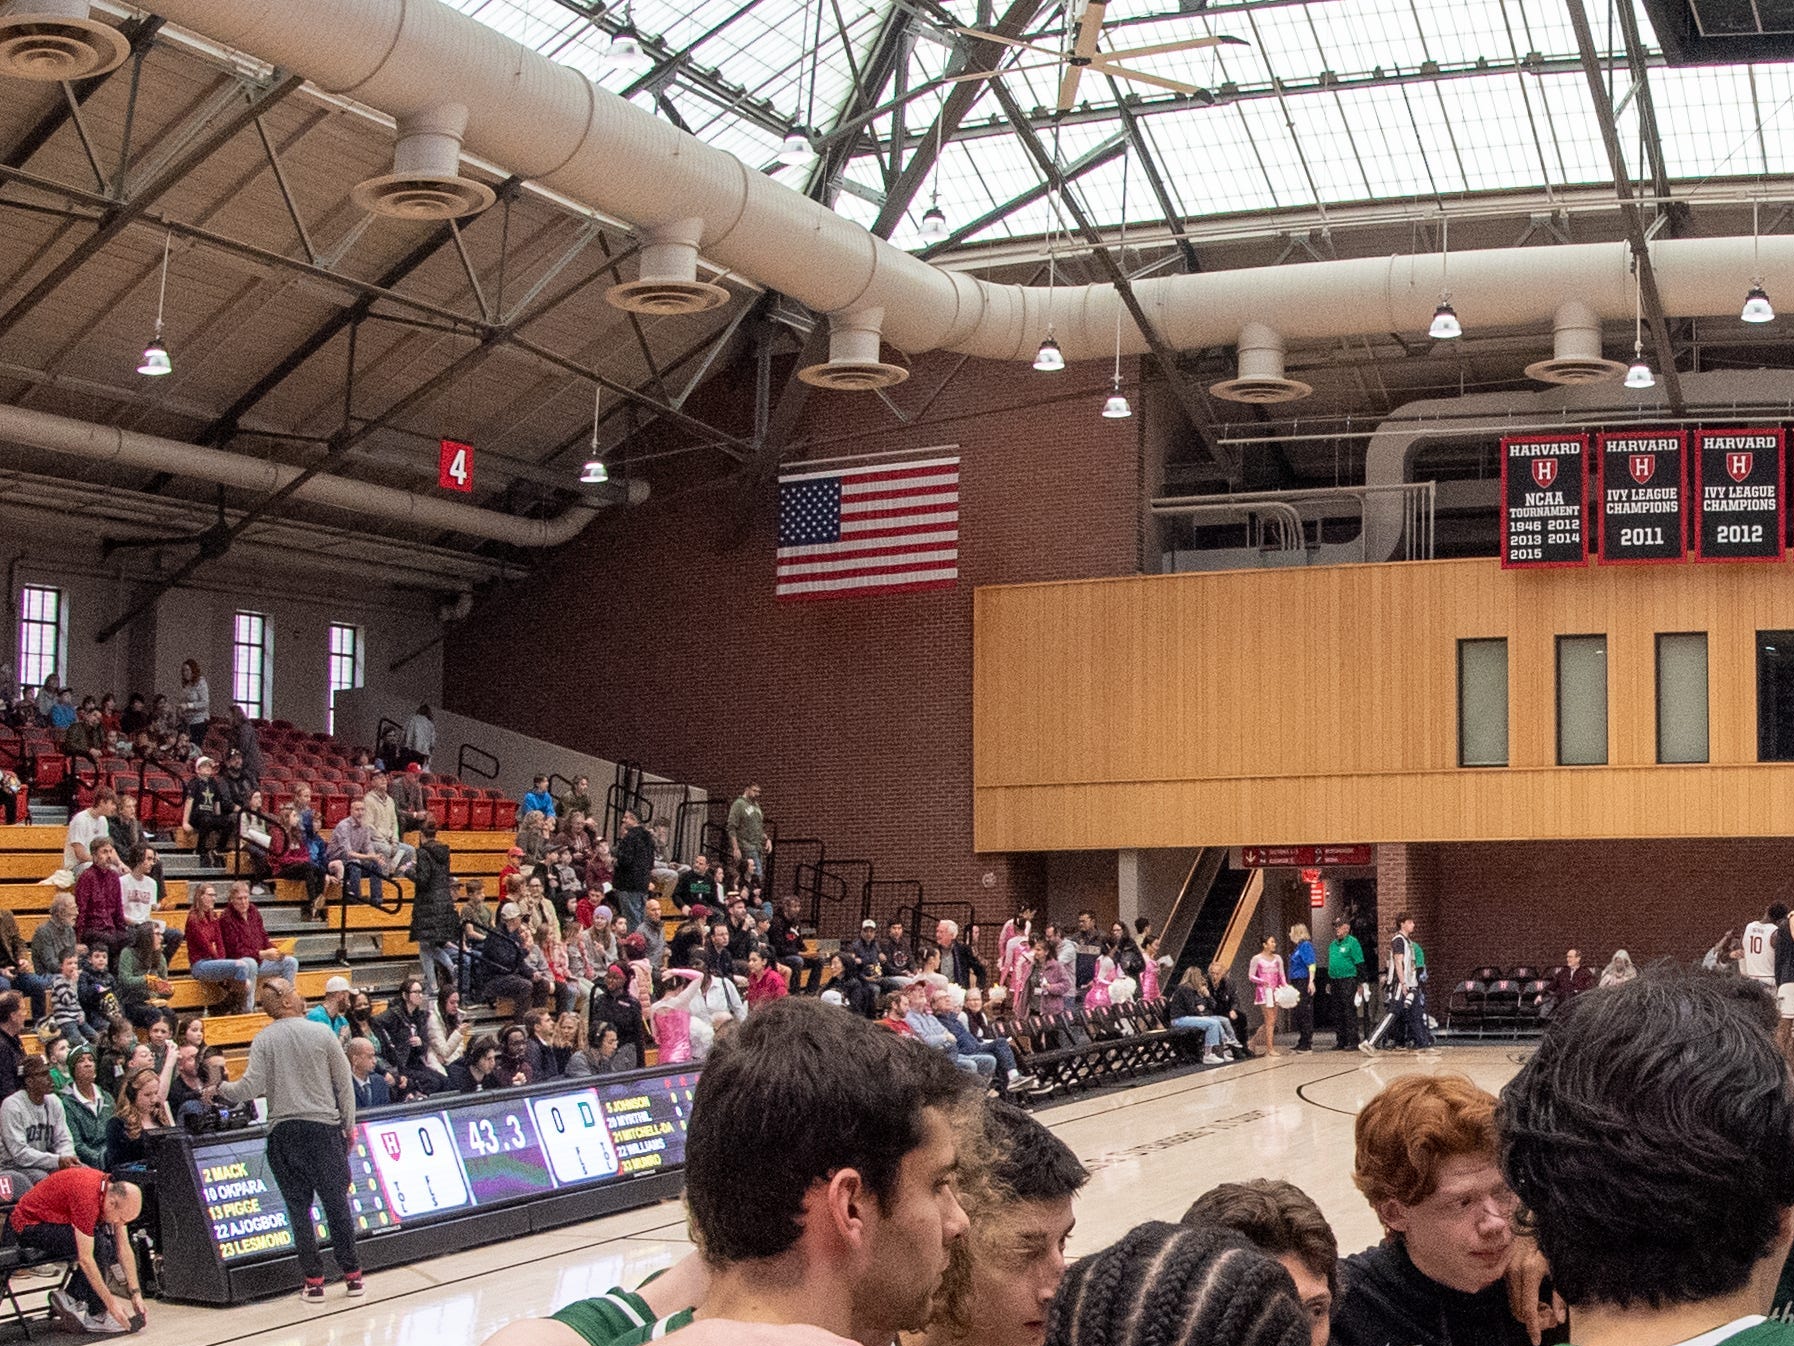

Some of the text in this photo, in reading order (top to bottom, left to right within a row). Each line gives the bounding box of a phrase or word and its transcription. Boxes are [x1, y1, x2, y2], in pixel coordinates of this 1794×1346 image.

[1510, 443, 1579, 456] HARVARD
[1607, 439, 1677, 452] HARVARD
[1704, 437, 1775, 449] HARVARD
[449, 449, 468, 485] 4
[1539, 463, 1551, 479] H
[1636, 458, 1648, 475] H
[1733, 456, 1746, 473] H
[1526, 492, 1564, 506] NCAA
[1608, 488, 1677, 503] IVY LEAGUE
[1705, 486, 1775, 500] IVY LEAGUE
[1510, 505, 1579, 518] TOURNAMENT
[1607, 499, 1678, 514] CHAMPIONS
[1704, 497, 1775, 511] CHAMPIONS
[1511, 520, 1579, 531] 1946 2012
[1718, 525, 1762, 542] 2012
[1511, 533, 1579, 545] 2013 2014
[1621, 528, 1663, 545] 2011
[1511, 549, 1541, 559] 2015
[1750, 936, 1763, 954] 10
[551, 1107, 564, 1133] 0
[419, 1127, 434, 1156] 0
[468, 1115, 526, 1155] 43.3
[202, 1162, 248, 1183] 2 MACK
[203, 1179, 267, 1202] 10 OKPARA
[208, 1199, 261, 1221] 13 PIGGE
[214, 1213, 288, 1239] 22 AJOGBOR
[220, 1231, 291, 1258] 23 LESMOND
